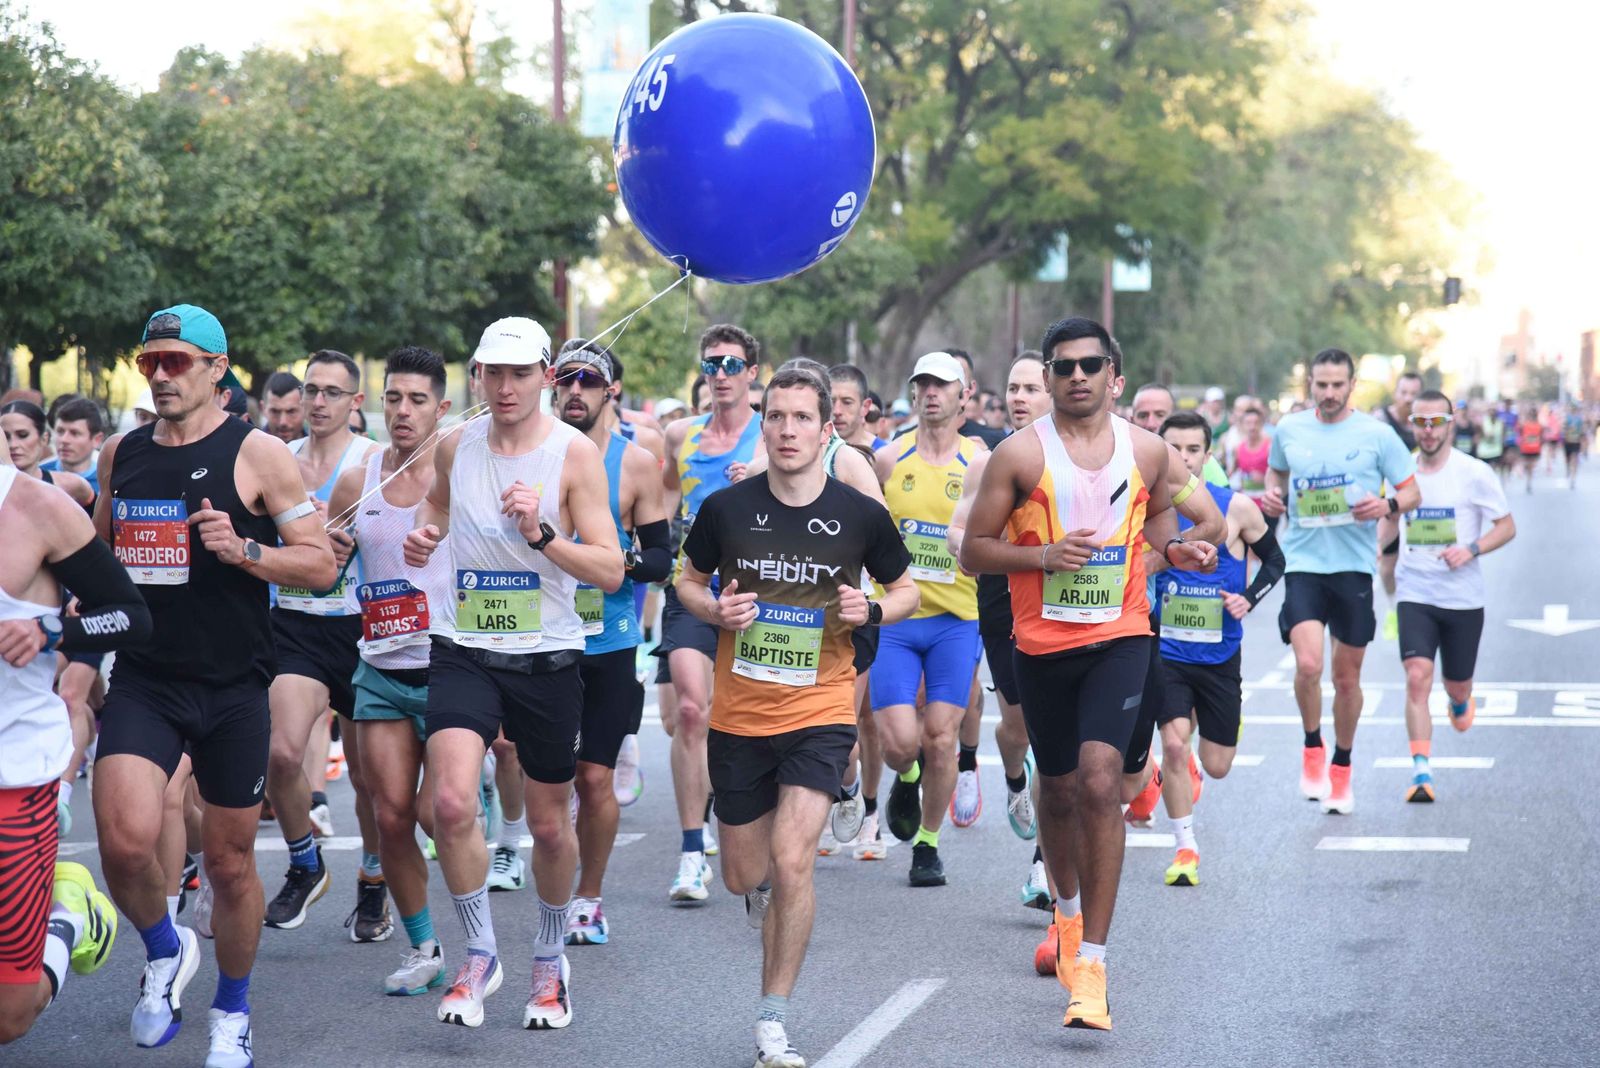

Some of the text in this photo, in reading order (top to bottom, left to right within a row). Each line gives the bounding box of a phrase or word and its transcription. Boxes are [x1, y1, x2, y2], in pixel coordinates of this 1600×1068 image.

[131, 505, 178, 517] ZURICH
[134, 530, 157, 542] 1472
[920, 525, 949, 537] ZURIC
[919, 543, 938, 552] 3220
[768, 552, 813, 562] TEAM
[482, 576, 529, 586] ZURICH
[1073, 575, 1099, 585] 2583
[1059, 589, 1110, 605] ARJUN
[1180, 586, 1216, 596] ZURICH
[484, 599, 508, 609] 2471
[379, 604, 400, 617] 1137
[765, 608, 814, 624] ZURICH
[476, 614, 517, 630] LARS
[1174, 614, 1206, 628] HUGO
[763, 632, 790, 645] 2360
[740, 641, 814, 667] BAPTISTE
